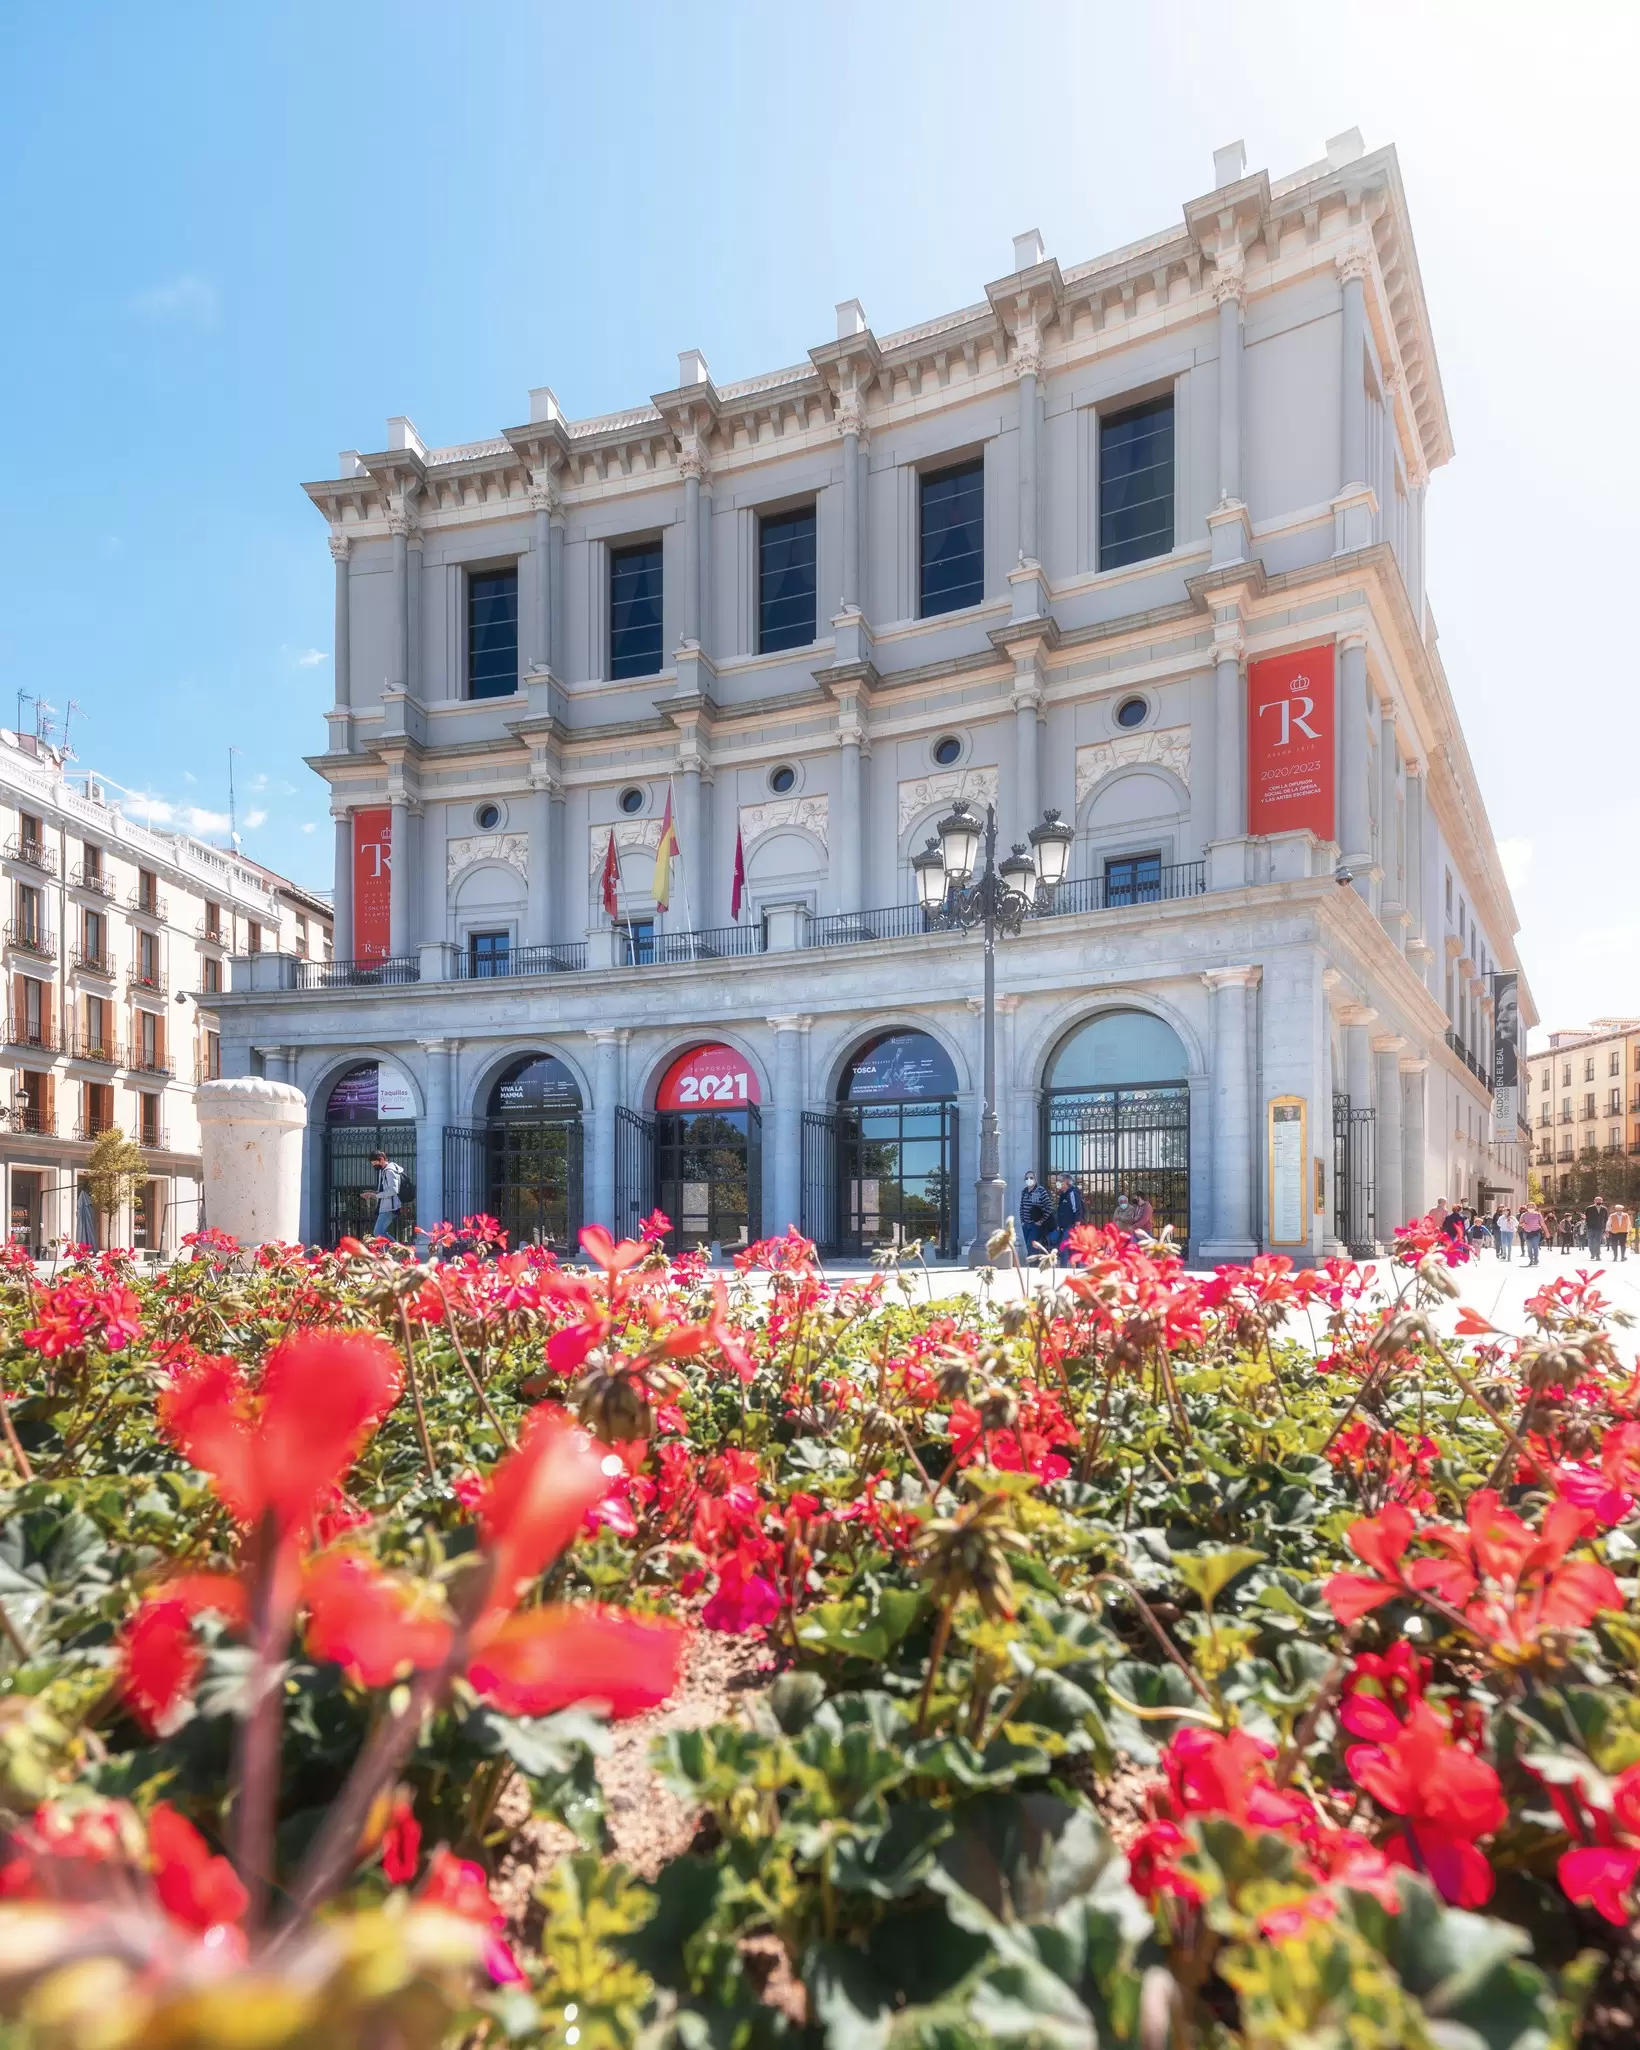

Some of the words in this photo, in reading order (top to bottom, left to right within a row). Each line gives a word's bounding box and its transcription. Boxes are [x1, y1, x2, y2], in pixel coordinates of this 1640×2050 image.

[1260, 760, 1321, 780] 2020/2023
[1496, 1047, 1504, 1065] REAL
[690, 1064, 737, 1073] TEMPORADA
[852, 1066, 877, 1074] TOSCA
[1496, 1065, 1504, 1075] EL
[1496, 1076, 1504, 1087] EN
[380, 1089, 408, 1097] Taquillas
[500, 1091, 524, 1099] MAMMA
